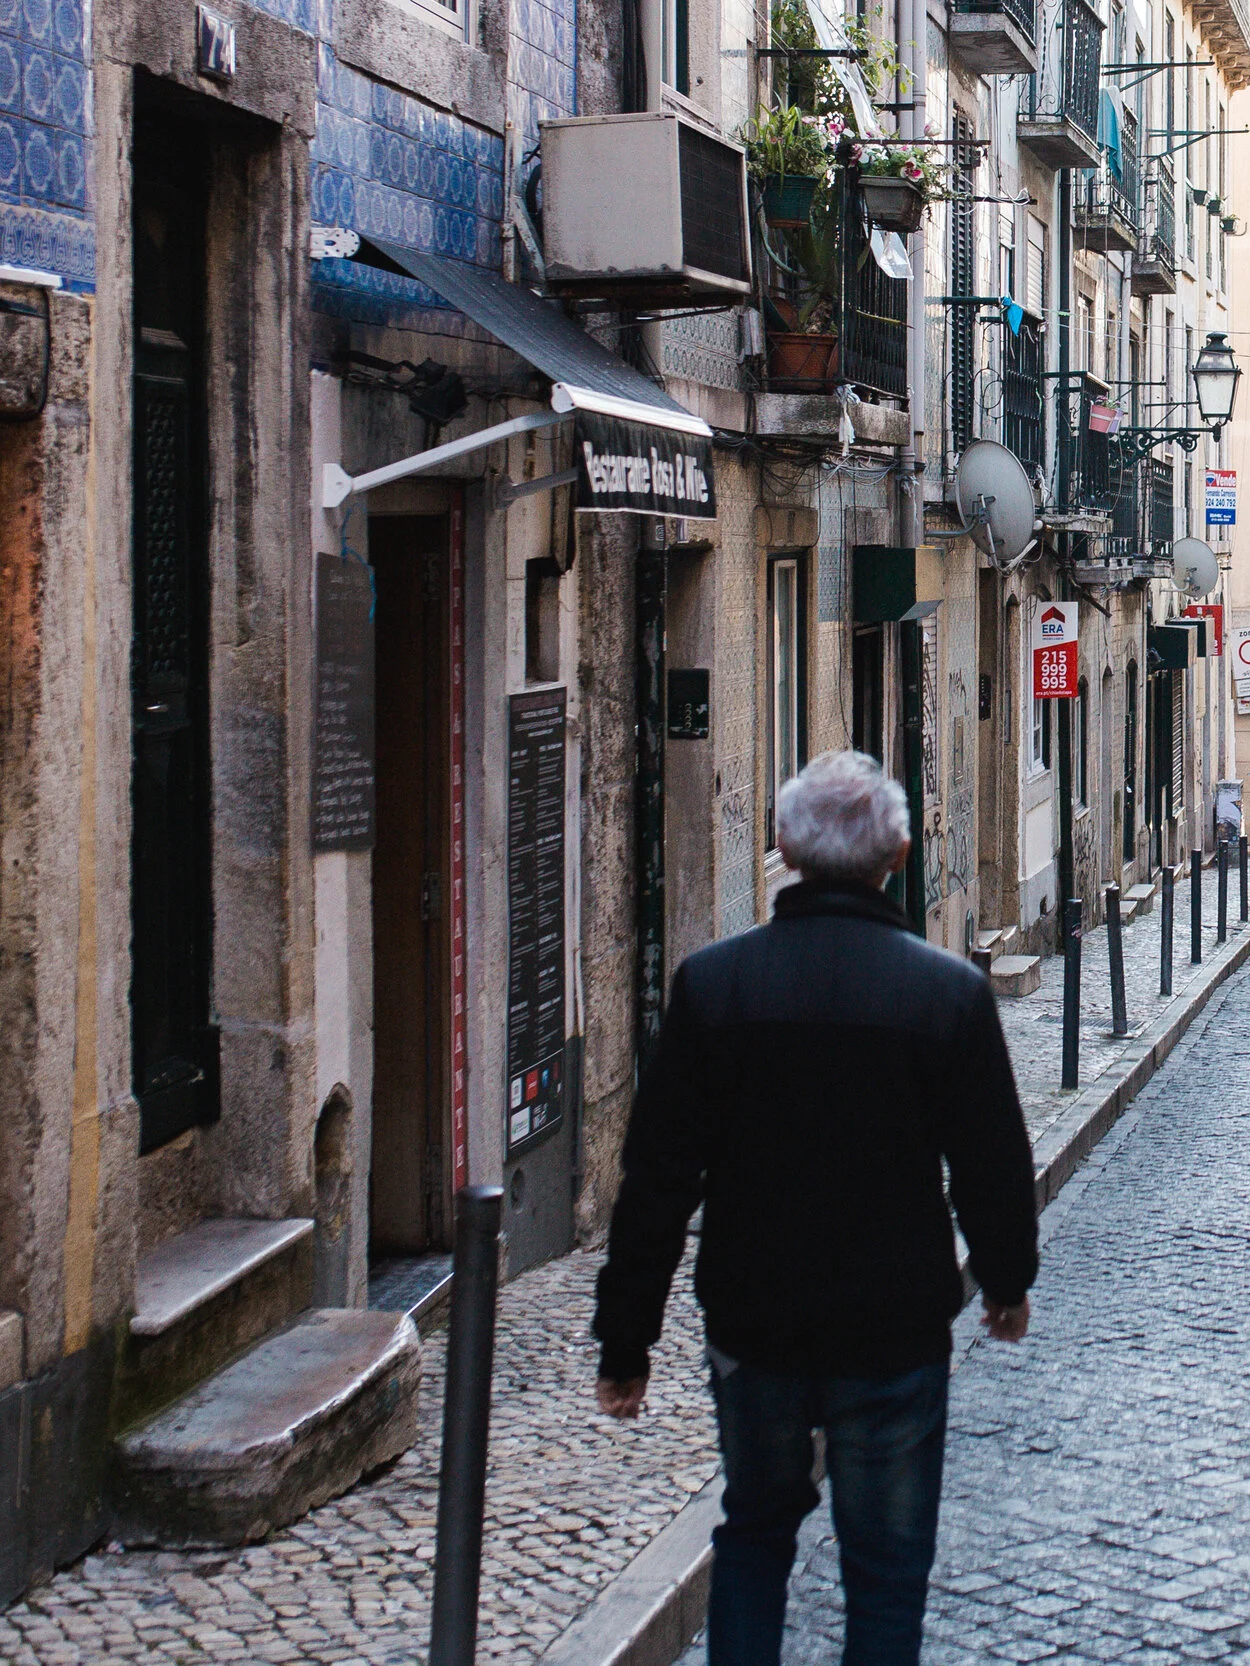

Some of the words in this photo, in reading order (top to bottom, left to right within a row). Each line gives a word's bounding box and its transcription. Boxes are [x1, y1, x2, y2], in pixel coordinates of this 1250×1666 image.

[1215, 473, 1236, 487] Vende
[1042, 624, 1064, 634] ERA
[1041, 651, 1067, 664] 215
[1041, 664, 1067, 677] 999
[1041, 676, 1067, 690] 995
